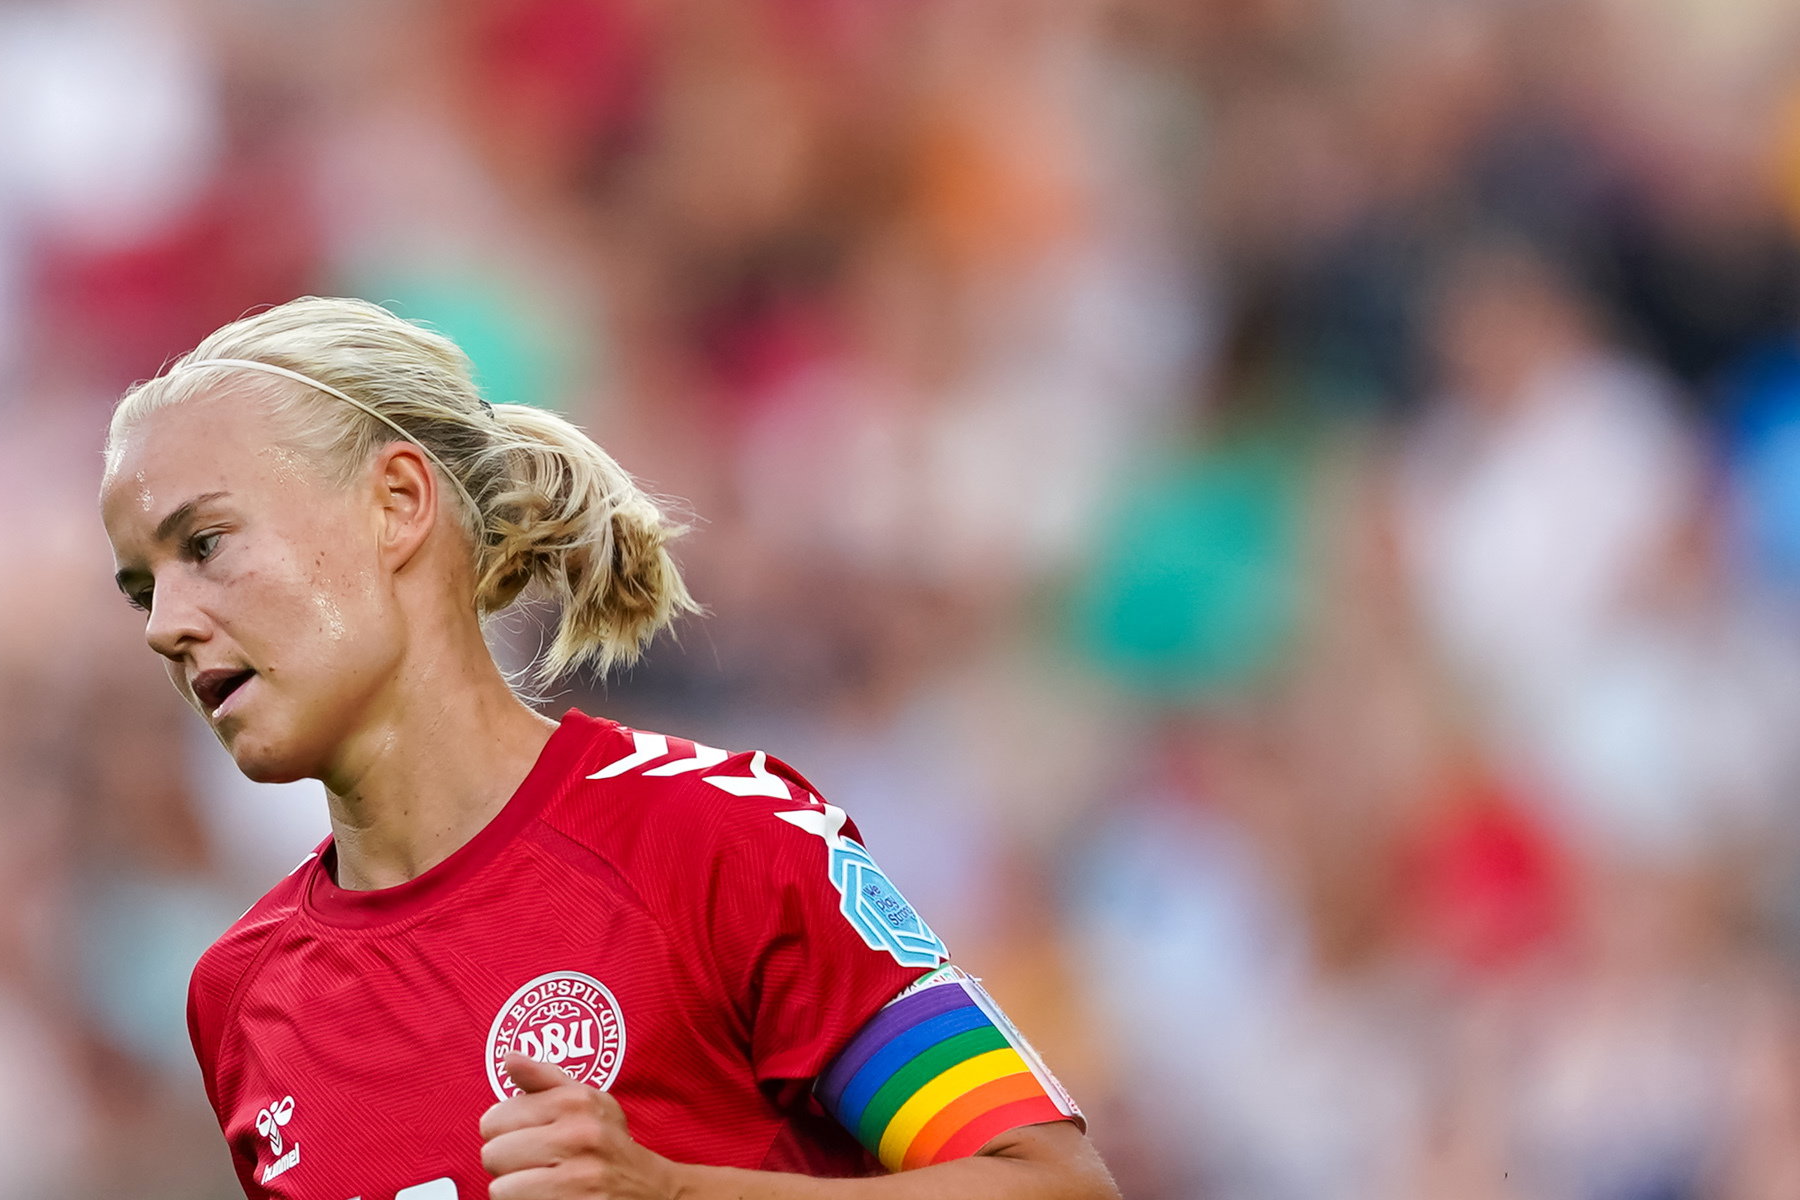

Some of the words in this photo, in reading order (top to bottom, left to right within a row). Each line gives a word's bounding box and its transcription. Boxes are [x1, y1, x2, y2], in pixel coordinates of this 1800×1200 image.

[862, 884, 881, 897] We
[518, 1018, 595, 1064] DBU
[260, 1141, 301, 1186] hummel
